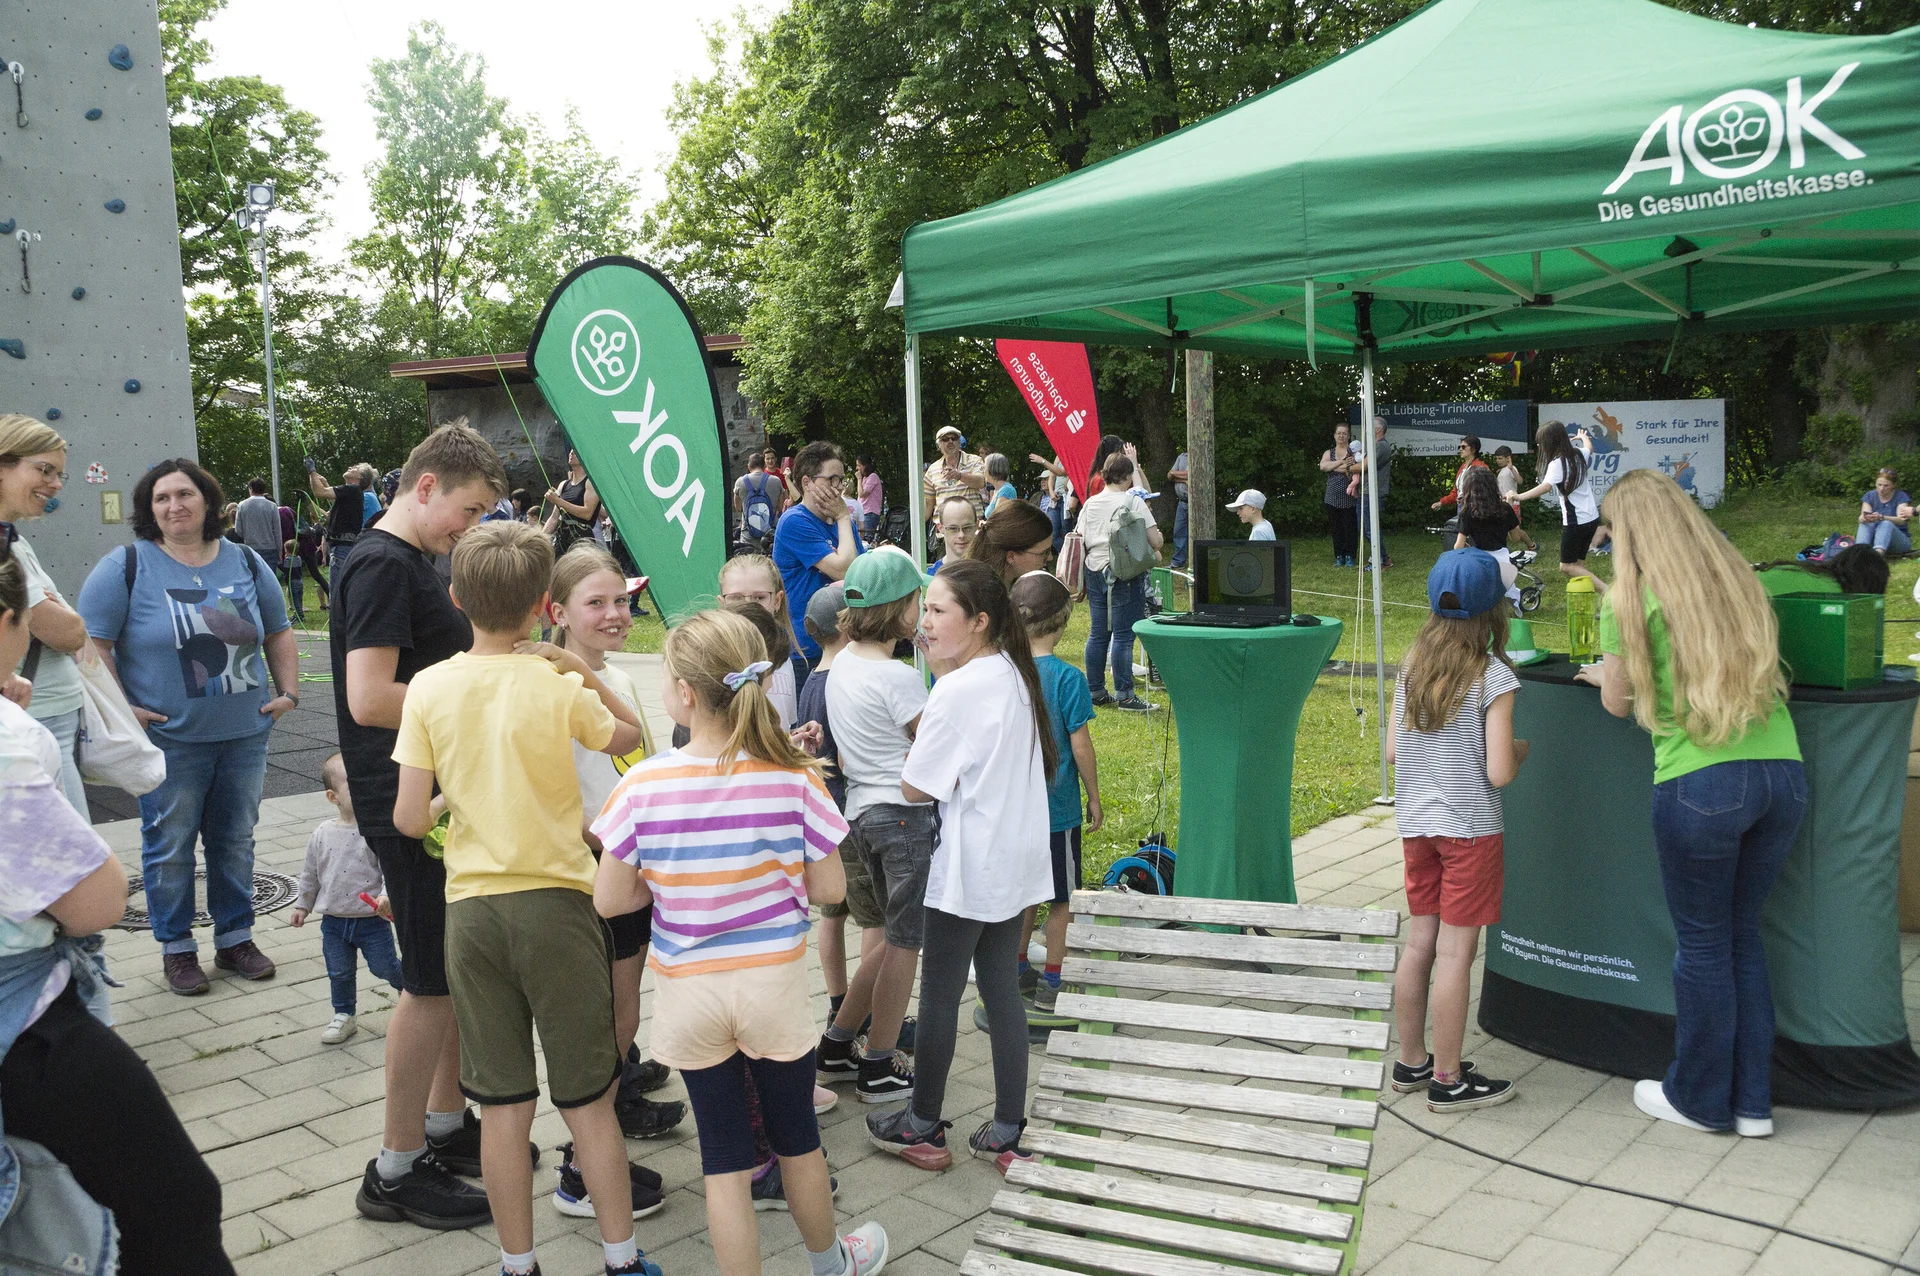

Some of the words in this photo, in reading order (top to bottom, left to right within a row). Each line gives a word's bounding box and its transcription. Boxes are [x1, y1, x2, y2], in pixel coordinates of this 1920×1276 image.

[1602, 61, 1867, 195] AOK
[1597, 201, 1634, 223] Die
[1639, 168, 1874, 217] Gesundheitskasse.
[1393, 402, 1507, 417] Lübbing-Trinkwalder
[1411, 417, 1465, 426] Rechtsanwältin
[1635, 419, 1667, 430] Stark
[1671, 418, 1690, 428] für
[1694, 418, 1719, 428] Ihre
[1645, 434, 1709, 445] Gesundheit!
[1500, 930, 1535, 949] Gesundheit
[1536, 943, 1567, 956] nehmen
[1567, 950, 1582, 959] wir
[1583, 954, 1635, 969] persönlich.
[1501, 942, 1515, 954] AOK
[1515, 947, 1541, 962] Bayern.
[1541, 955, 1554, 966] Die
[1555, 958, 1640, 982] Gesundheitskasse.
